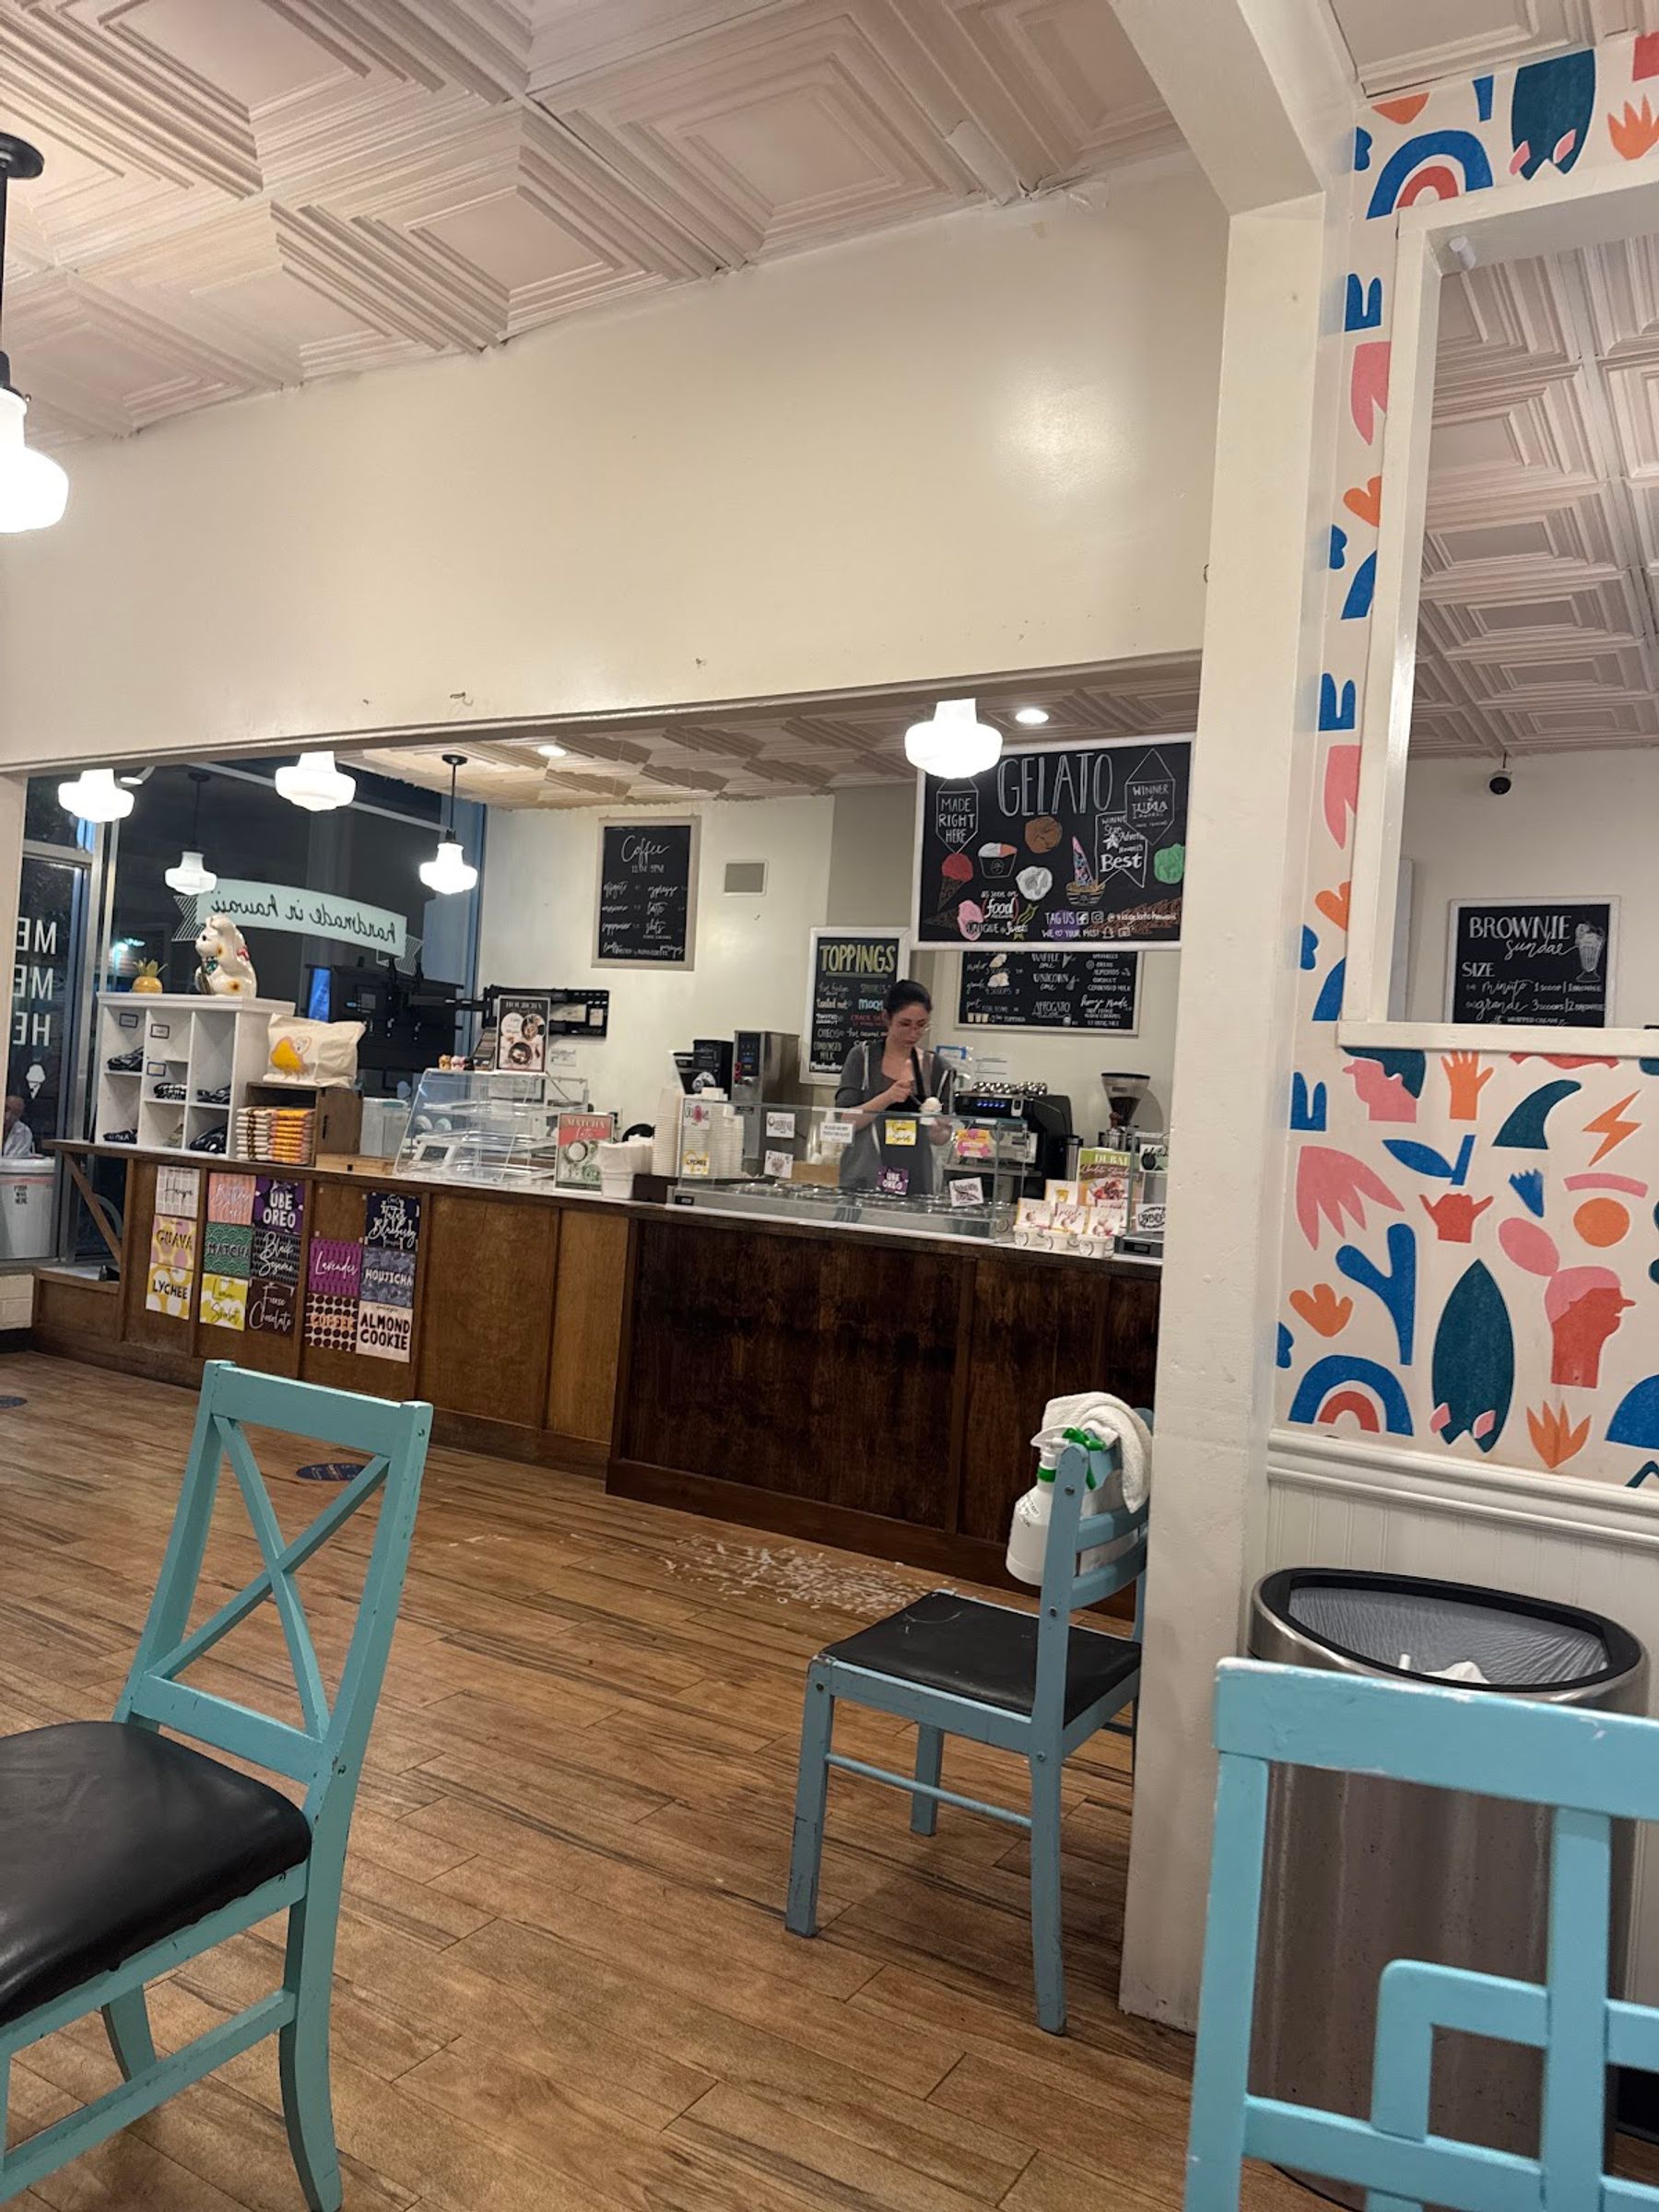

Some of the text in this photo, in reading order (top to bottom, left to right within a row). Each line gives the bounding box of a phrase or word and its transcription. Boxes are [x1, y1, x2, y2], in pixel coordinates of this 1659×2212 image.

[997, 752, 1113, 817] GELATO
[1133, 784, 1170, 796] WINNER
[941, 797, 971, 813] MADE
[938, 813, 976, 829] RIGHT
[1101, 815, 1127, 825] WINNE
[945, 829, 968, 843] HERE
[621, 835, 670, 867] Coffee
[1100, 853, 1143, 872] Best
[983, 897, 1016, 919] food
[1044, 912, 1063, 924] TAG
[1064, 912, 1075, 924] US
[1469, 915, 1571, 940] BROWNIE
[1504, 932, 1579, 960] sundae
[819, 944, 896, 972] TOPPINGS
[1031, 953, 1060, 962] WAFFLE
[1032, 972, 1069, 982] UNICORN
[1462, 962, 1496, 977] SIZE
[1033, 1001, 1071, 1013] AFFOGATO
[568, 1118, 605, 1128] MATCHA
[1094, 1154, 1128, 1166] DUBAI
[269, 1191, 293, 1210] UBE
[263, 1207, 296, 1229] OREO
[156, 1230, 193, 1250] GUAVA
[206, 1241, 250, 1257] MATCHA
[315, 1251, 358, 1279] Lavender
[365, 1268, 413, 1286] HOUJICHA
[152, 1279, 189, 1300] LYCHEE
[249, 1300, 292, 1332] Chocolate
[311, 1314, 355, 1331] COFFEE
[360, 1312, 410, 1334] ALMOND
[360, 1331, 408, 1350] COOKIE
